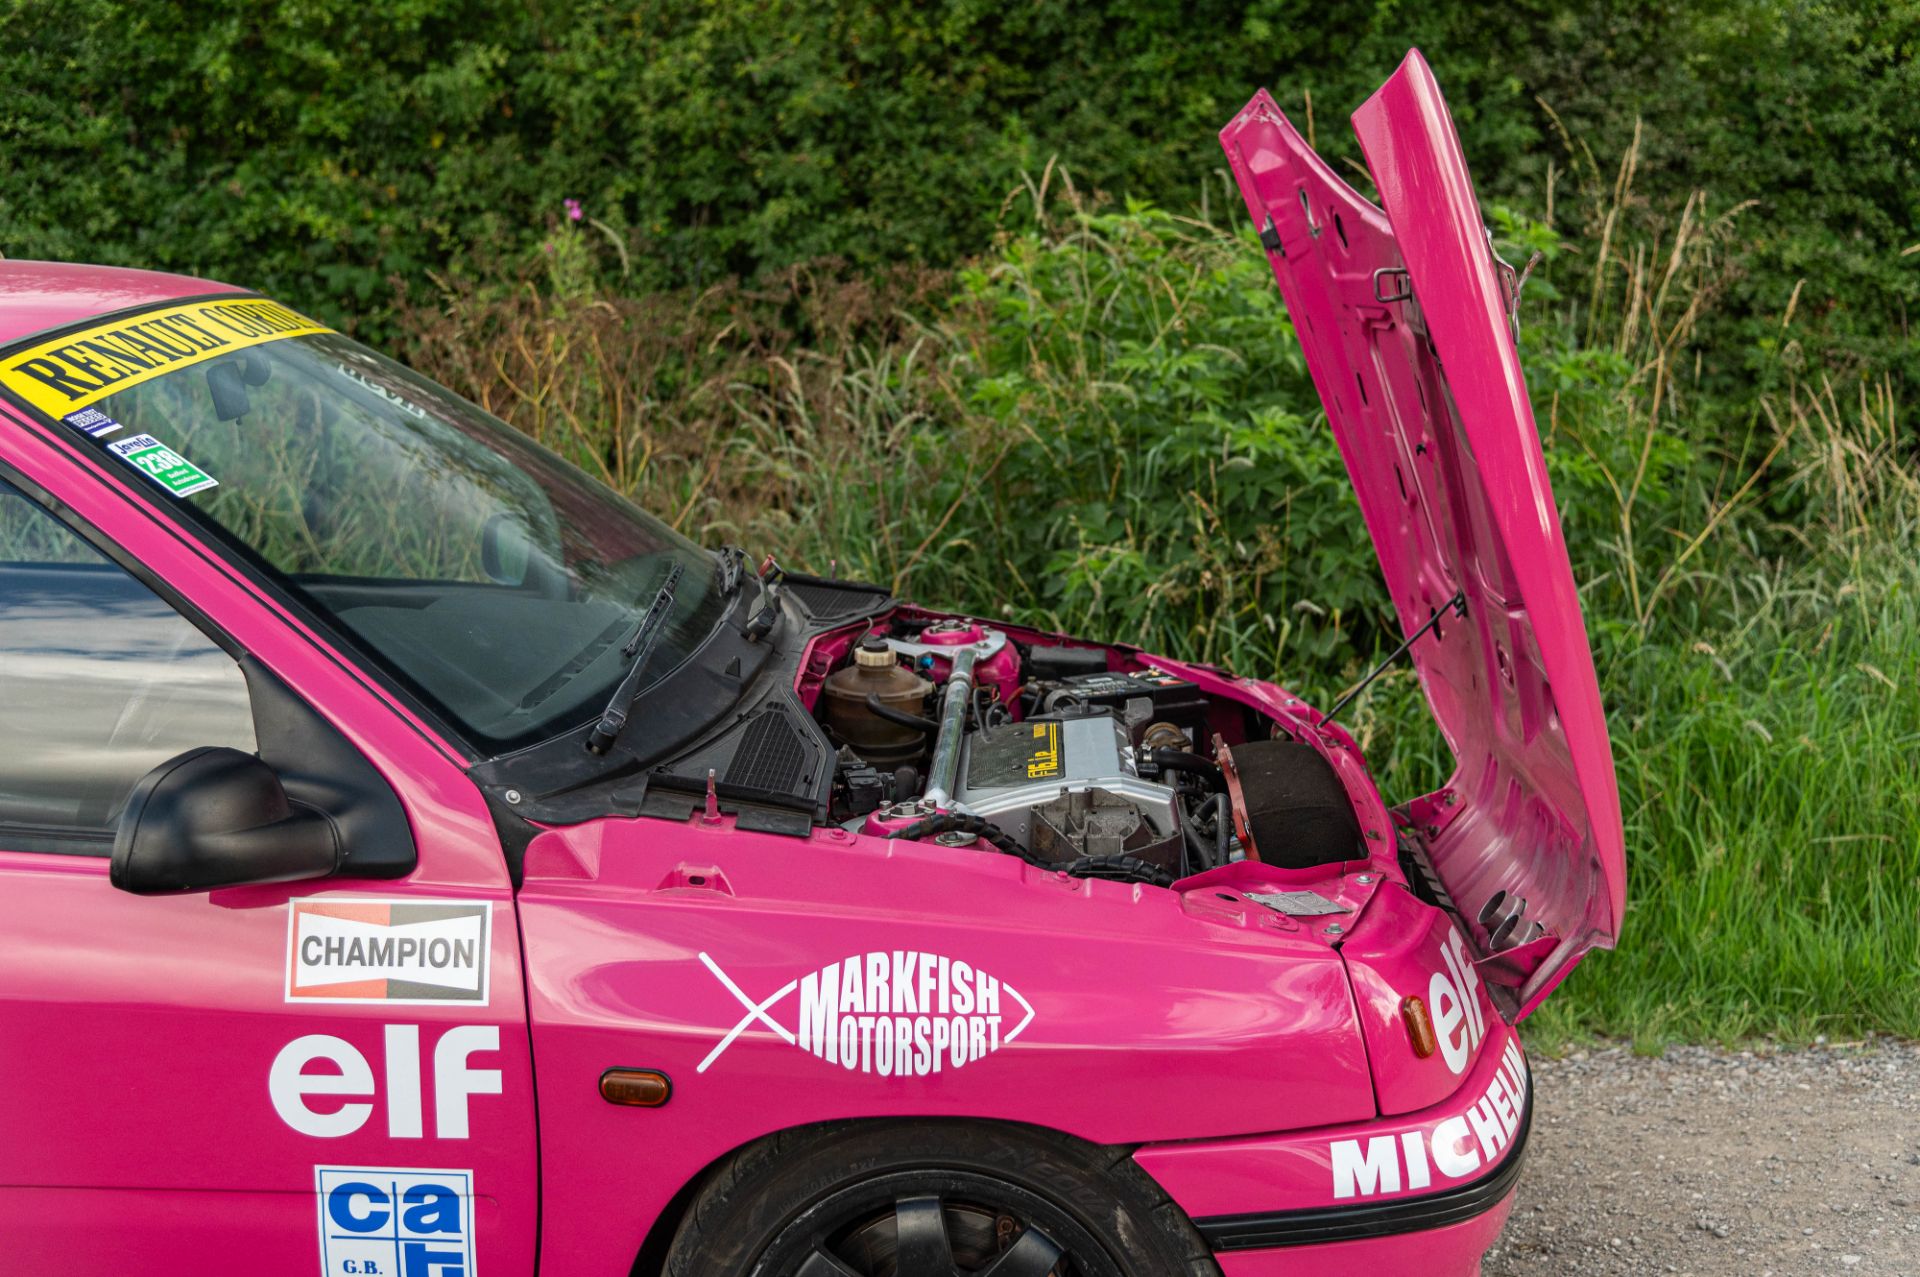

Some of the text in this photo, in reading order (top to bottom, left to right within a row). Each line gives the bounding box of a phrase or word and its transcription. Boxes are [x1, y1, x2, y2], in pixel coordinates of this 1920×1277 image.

[11, 313, 231, 402] RENAULT
[136, 449, 184, 475] 238
[301, 935, 475, 969] CHAMPION
[800, 951, 1000, 1064] MARKFISH
[1429, 925, 1485, 1075] elf
[799, 962, 1002, 1076] MOTORSPORT
[269, 1024, 502, 1139] elf
[1330, 1036, 1528, 1199] MICHELIN
[342, 1259, 383, 1275] G.B.
